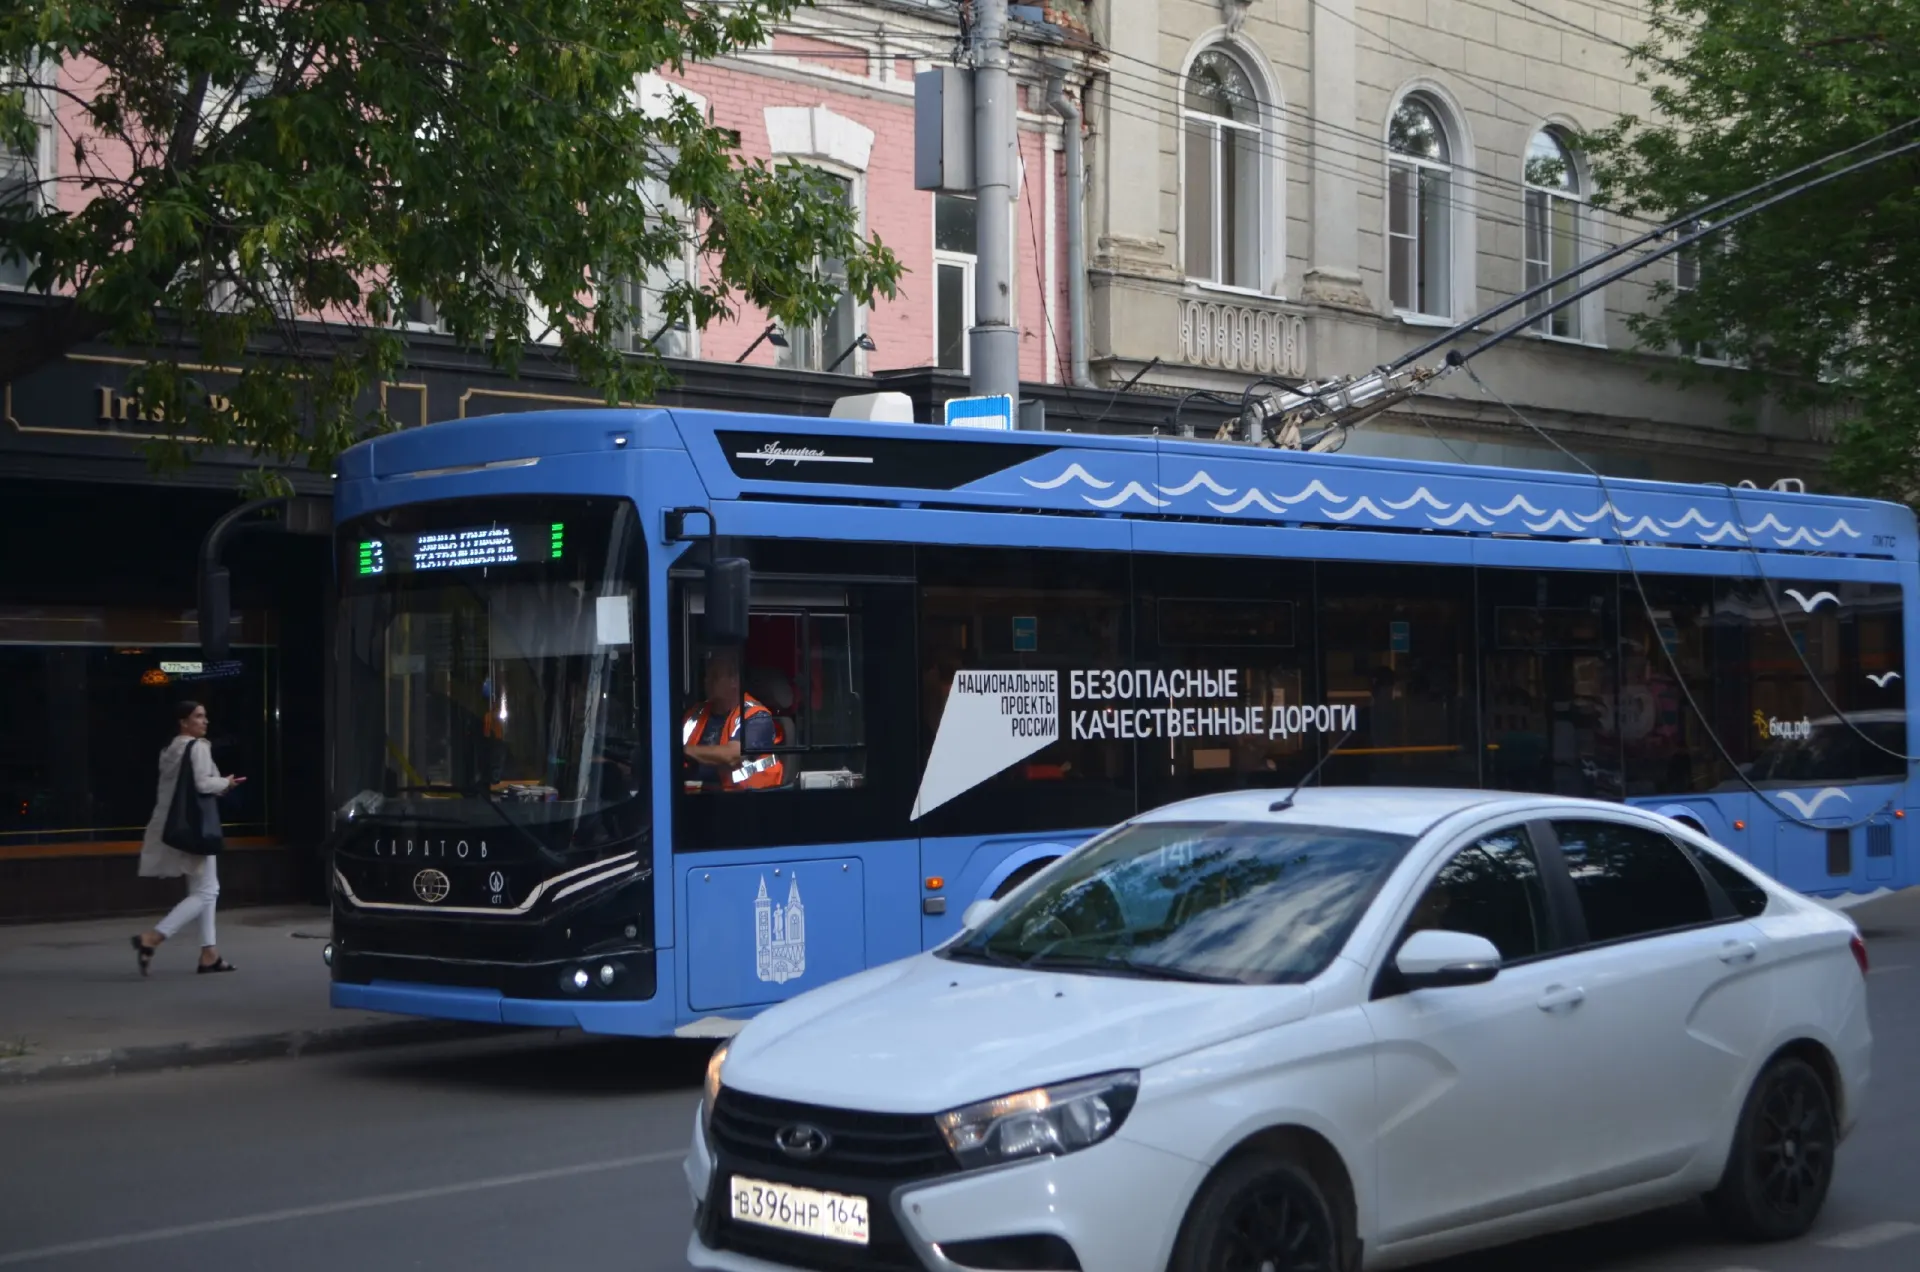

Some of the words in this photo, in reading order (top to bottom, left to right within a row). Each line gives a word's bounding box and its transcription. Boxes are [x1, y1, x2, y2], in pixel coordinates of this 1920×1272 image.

[100, 386, 187, 424] Iris
[957, 673, 1056, 696] НАЦИОНАЛЬНЫЕ
[1070, 669, 1238, 700] БЕЗОПАСНЫЕ
[1001, 695, 1056, 716] ПРОЕКТЫ
[1011, 717, 1057, 738] РОССИИ
[1071, 705, 1264, 740] КАЧЕСТВЕННЫЕ
[1269, 704, 1357, 740] ДОРОГИ
[374, 839, 488, 858] САРАТОВ
[739, 1187, 820, 1226] В396НР
[827, 1198, 862, 1226] 164
